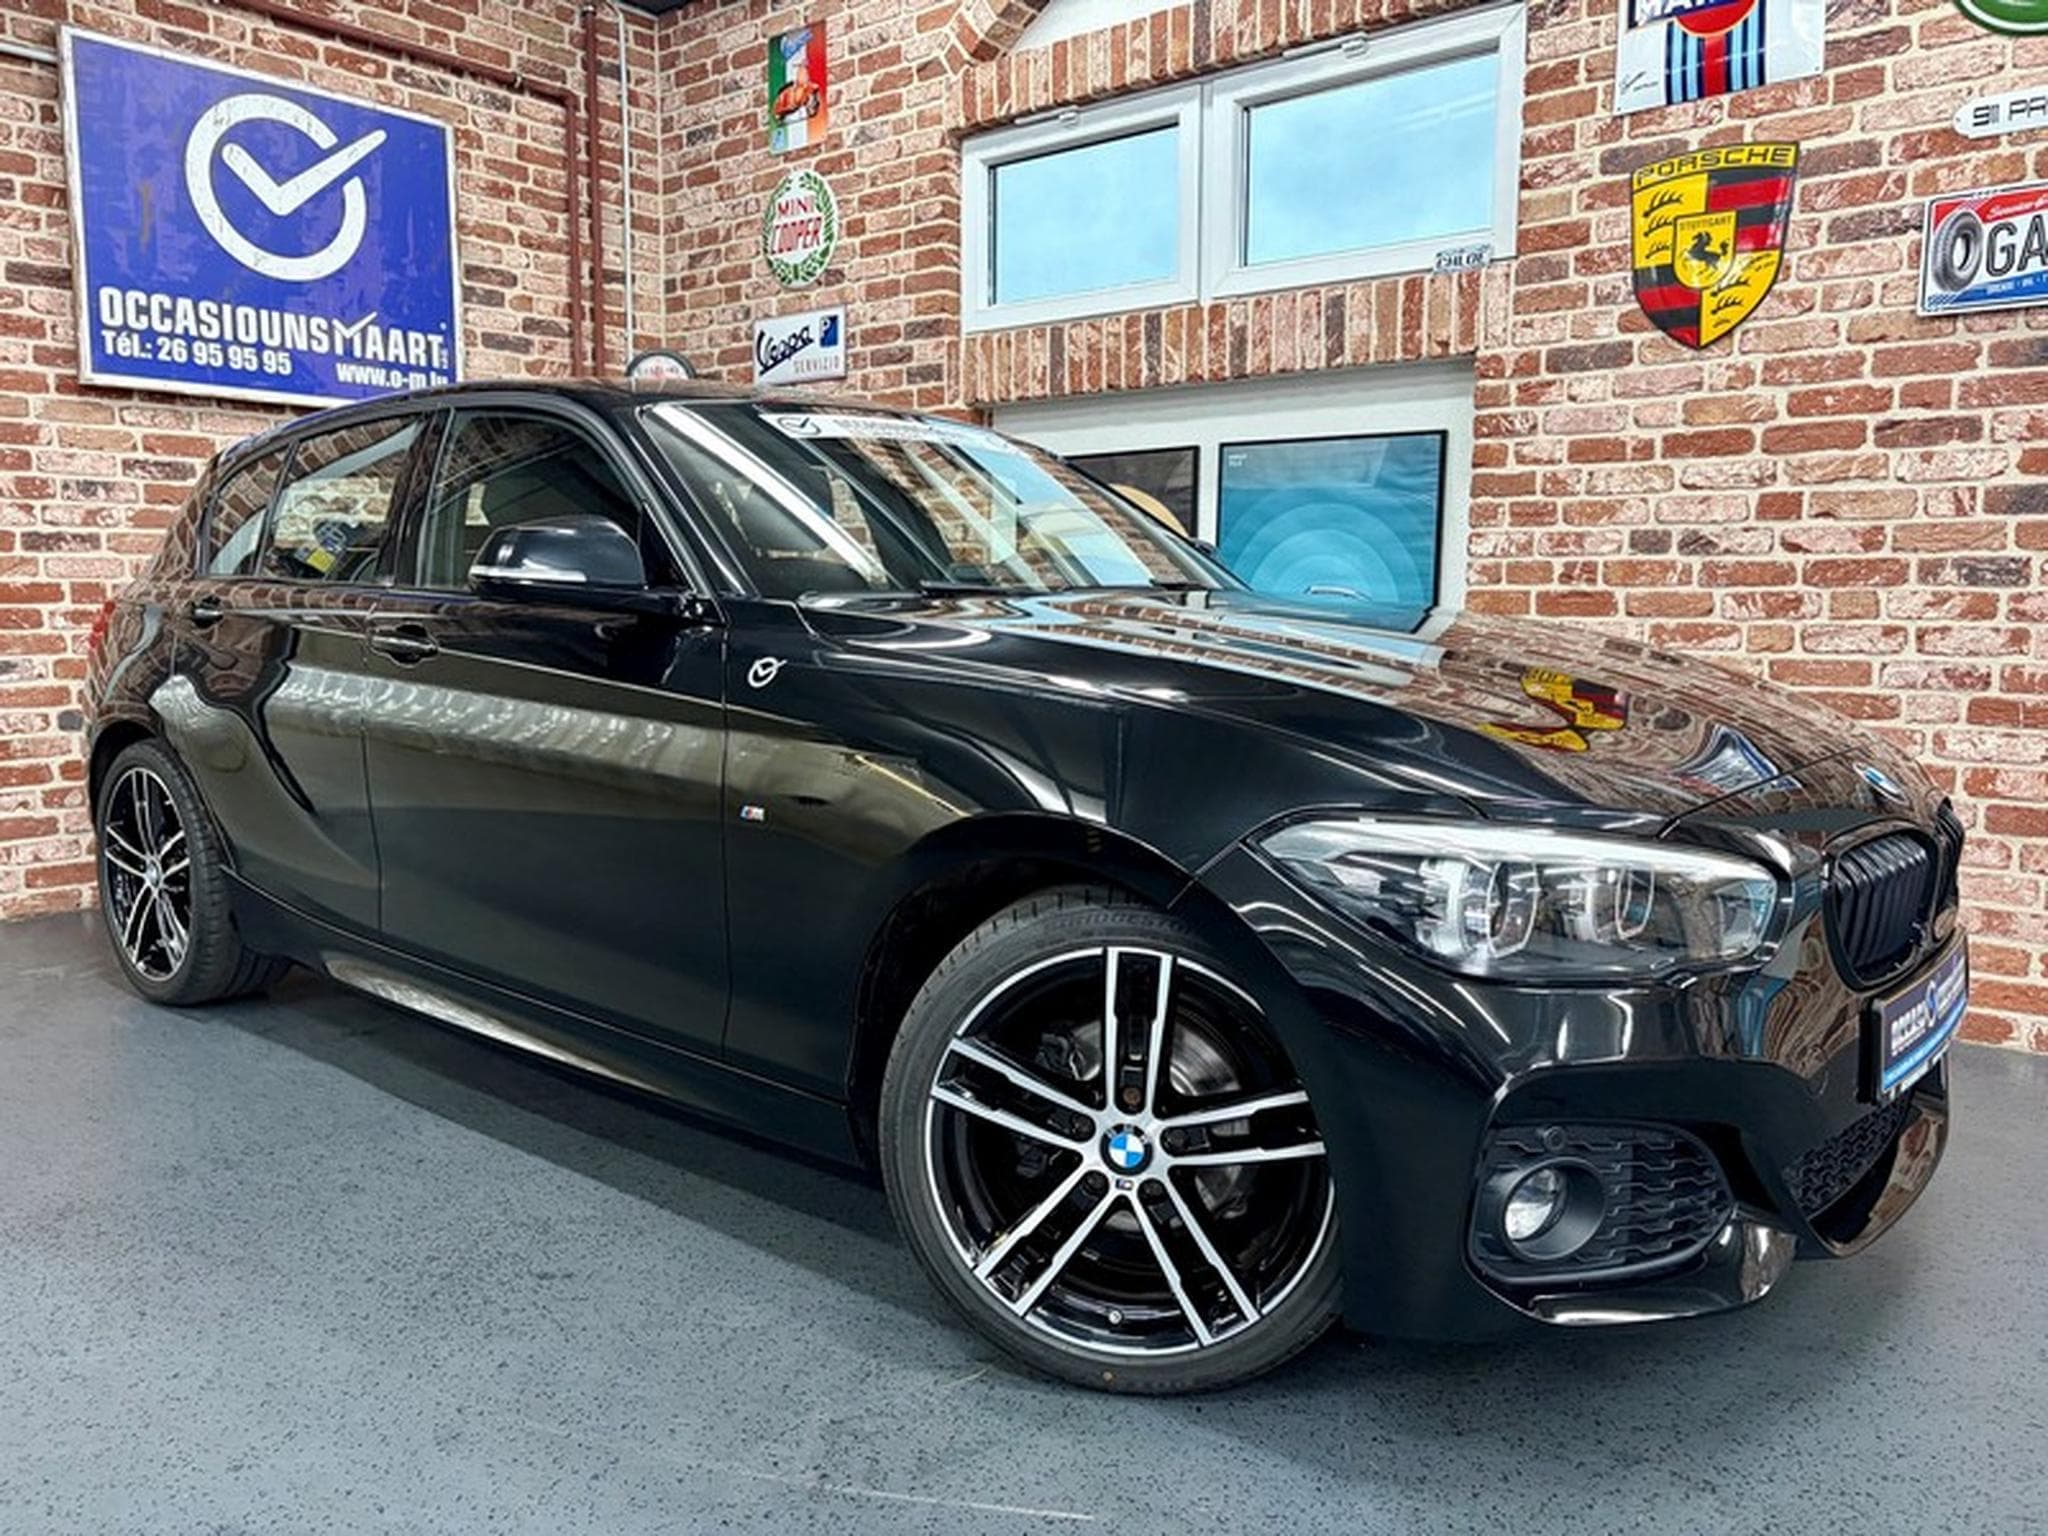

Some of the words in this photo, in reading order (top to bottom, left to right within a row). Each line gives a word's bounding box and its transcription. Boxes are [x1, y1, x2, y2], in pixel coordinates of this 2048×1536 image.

[1636, 147, 1792, 186] PORSCHE
[777, 195, 817, 216] MINI
[771, 216, 822, 254] COOPER
[156, 336, 188, 364] 26
[193, 340, 224, 367] 95
[227, 345, 259, 372] 95
[262, 348, 292, 376] 95
[757, 325, 815, 375] Vespa
